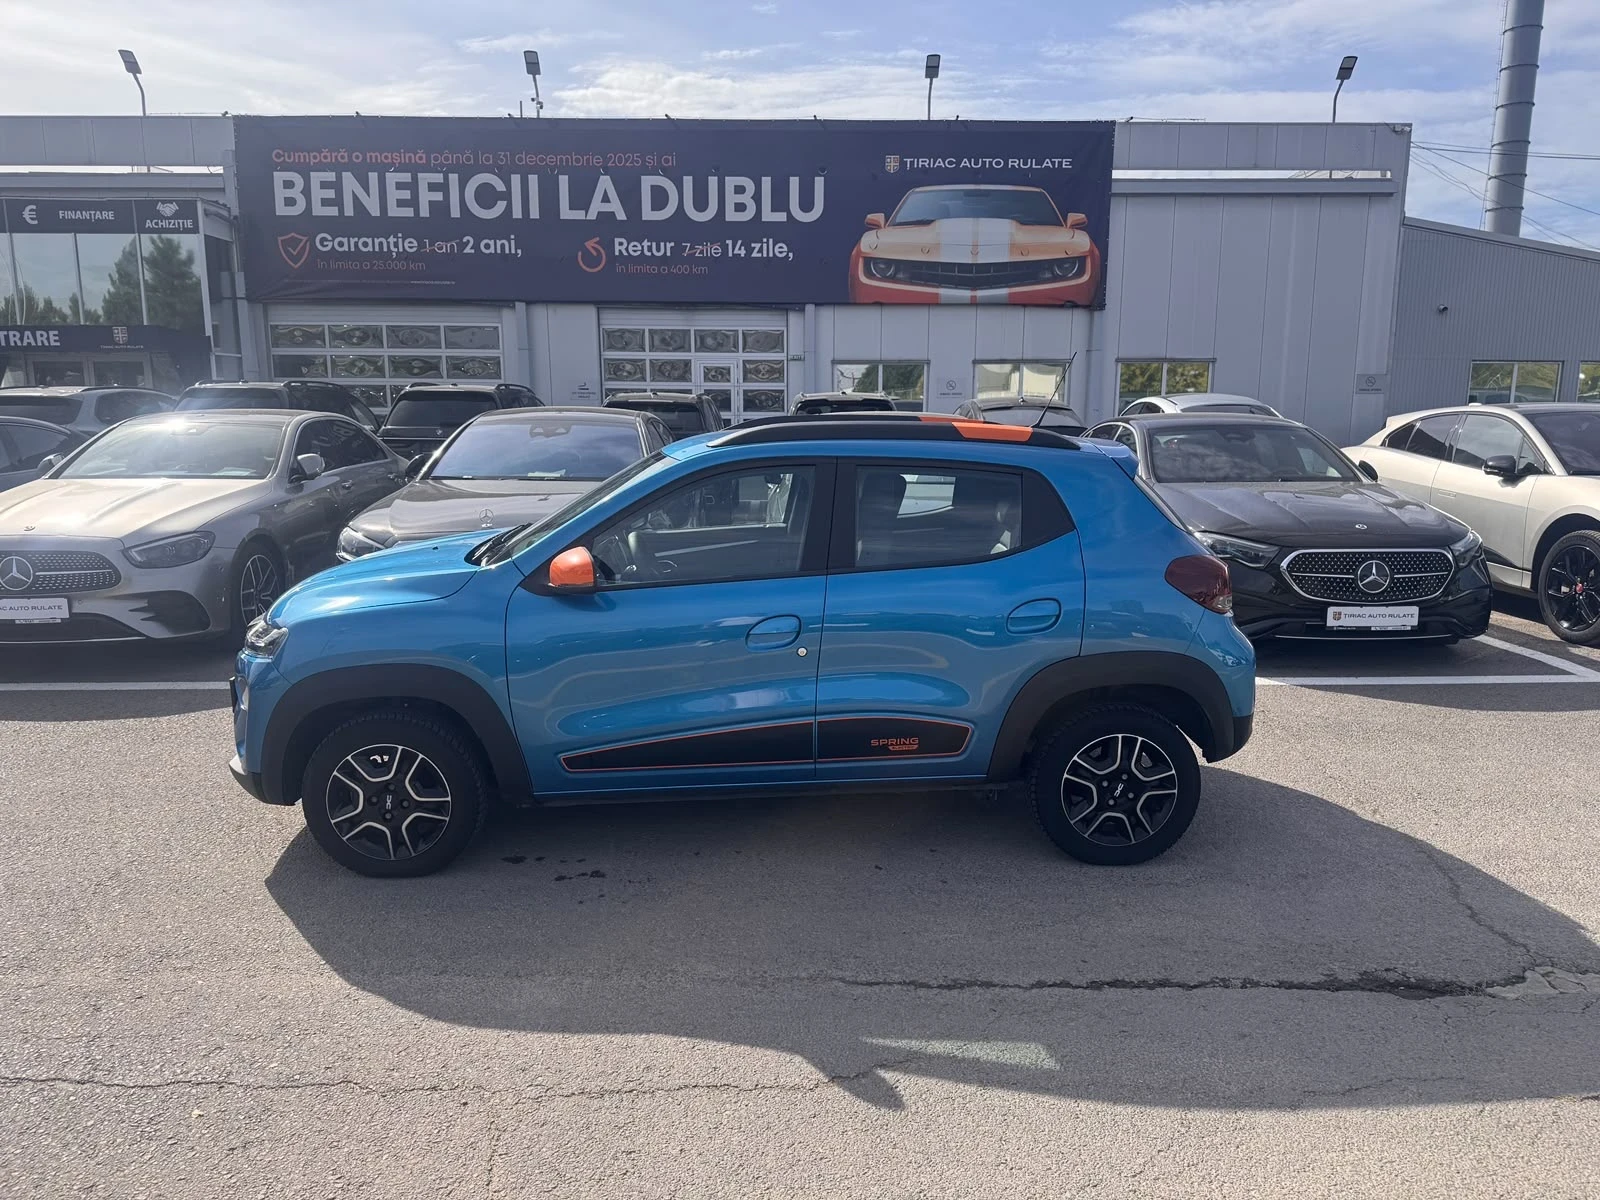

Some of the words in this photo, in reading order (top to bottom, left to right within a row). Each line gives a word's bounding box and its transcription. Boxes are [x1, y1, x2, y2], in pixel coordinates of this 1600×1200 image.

[272, 149, 348, 165] Cumpără
[352, 153, 363, 163] o
[366, 149, 426, 167] mașină
[430, 150, 474, 166] până
[478, 150, 493, 165] la
[497, 151, 512, 165] 31
[515, 151, 603, 166] decembrie
[607, 153, 642, 167] 2025
[645, 153, 658, 169] și
[661, 152, 676, 167] ai
[959, 158, 1004, 169] AUTO
[1008, 158, 1073, 169] RULATE
[273, 171, 540, 220] BENEFICII
[558, 174, 628, 221] LA
[640, 175, 825, 222] DUBLU
[58, 210, 115, 223] FINANȚARE
[145, 219, 193, 231] ACHIZIȚIE
[315, 232, 418, 259] Garanție
[462, 235, 475, 254] 2
[480, 234, 522, 258] ani,
[614, 237, 675, 257] Retur
[681, 242, 691, 257] 7
[694, 242, 722, 257] zile
[725, 239, 746, 258] 14
[751, 238, 793, 261] zile,
[330, 259, 360, 270] limita
[362, 261, 371, 270] a
[372, 260, 406, 270] 25.000
[409, 260, 426, 271] km
[628, 264, 658, 274] limita
[660, 266, 669, 274] a
[670, 264, 690, 274] 400
[692, 264, 708, 274] km
[870, 737, 919, 746] SPRING
